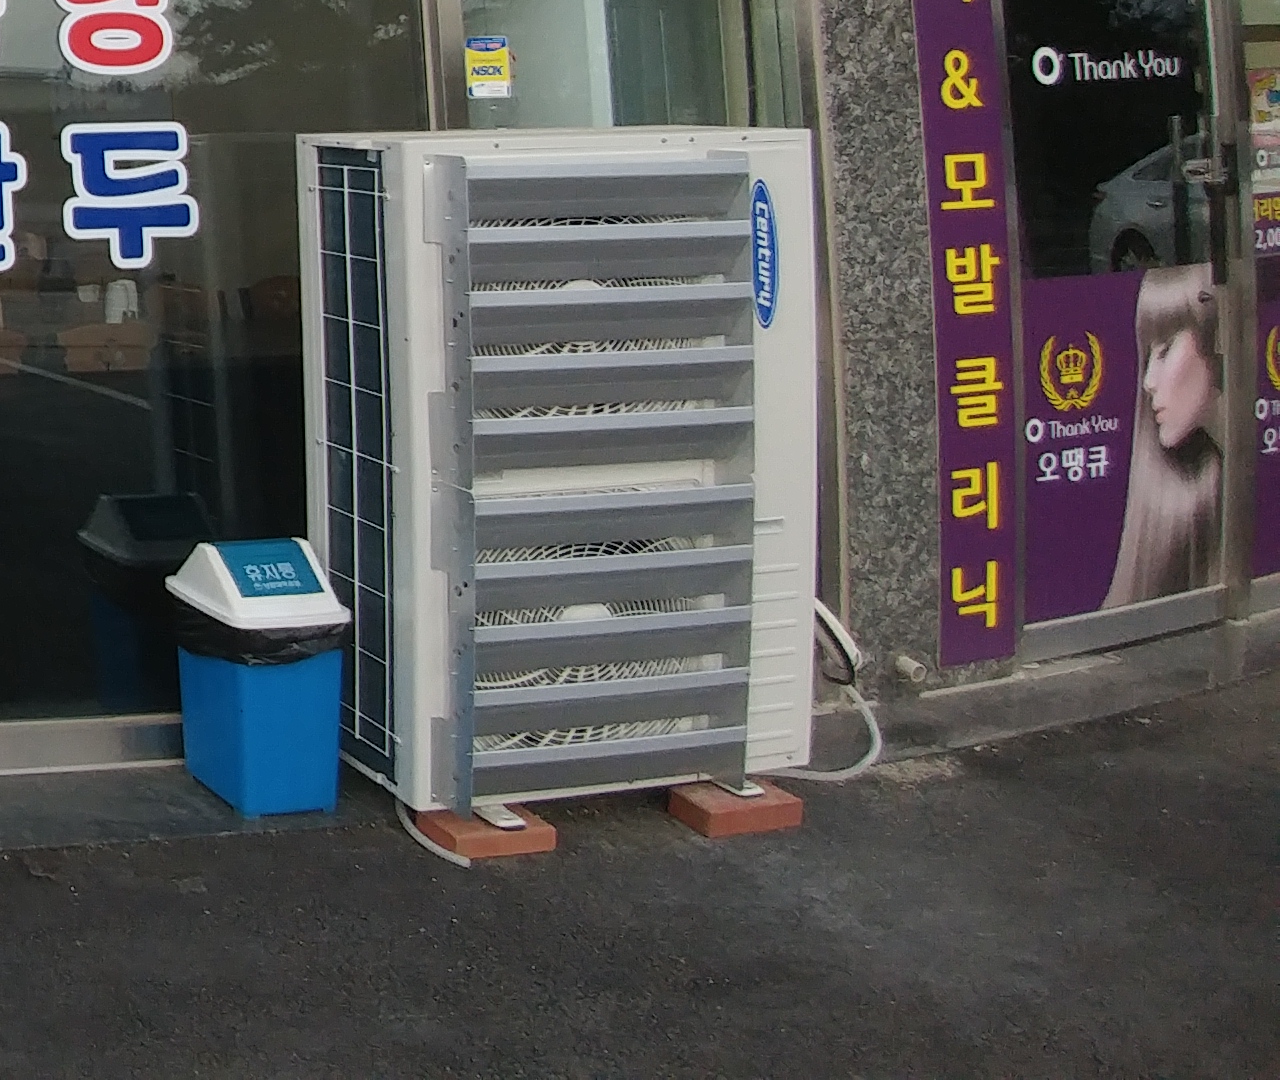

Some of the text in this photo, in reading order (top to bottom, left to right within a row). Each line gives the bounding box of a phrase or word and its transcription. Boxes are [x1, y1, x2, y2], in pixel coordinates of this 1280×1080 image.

[940, 49, 984, 110] &
[1067, 51, 1139, 82] Thank
[1137, 49, 1182, 79] You
[754, 200, 772, 308] Century
[1048, 418, 1092, 439] Thank
[1091, 415, 1119, 434] You
[1035, 445, 1110, 483] 오땡큐
[243, 561, 297, 582] 휴지통
